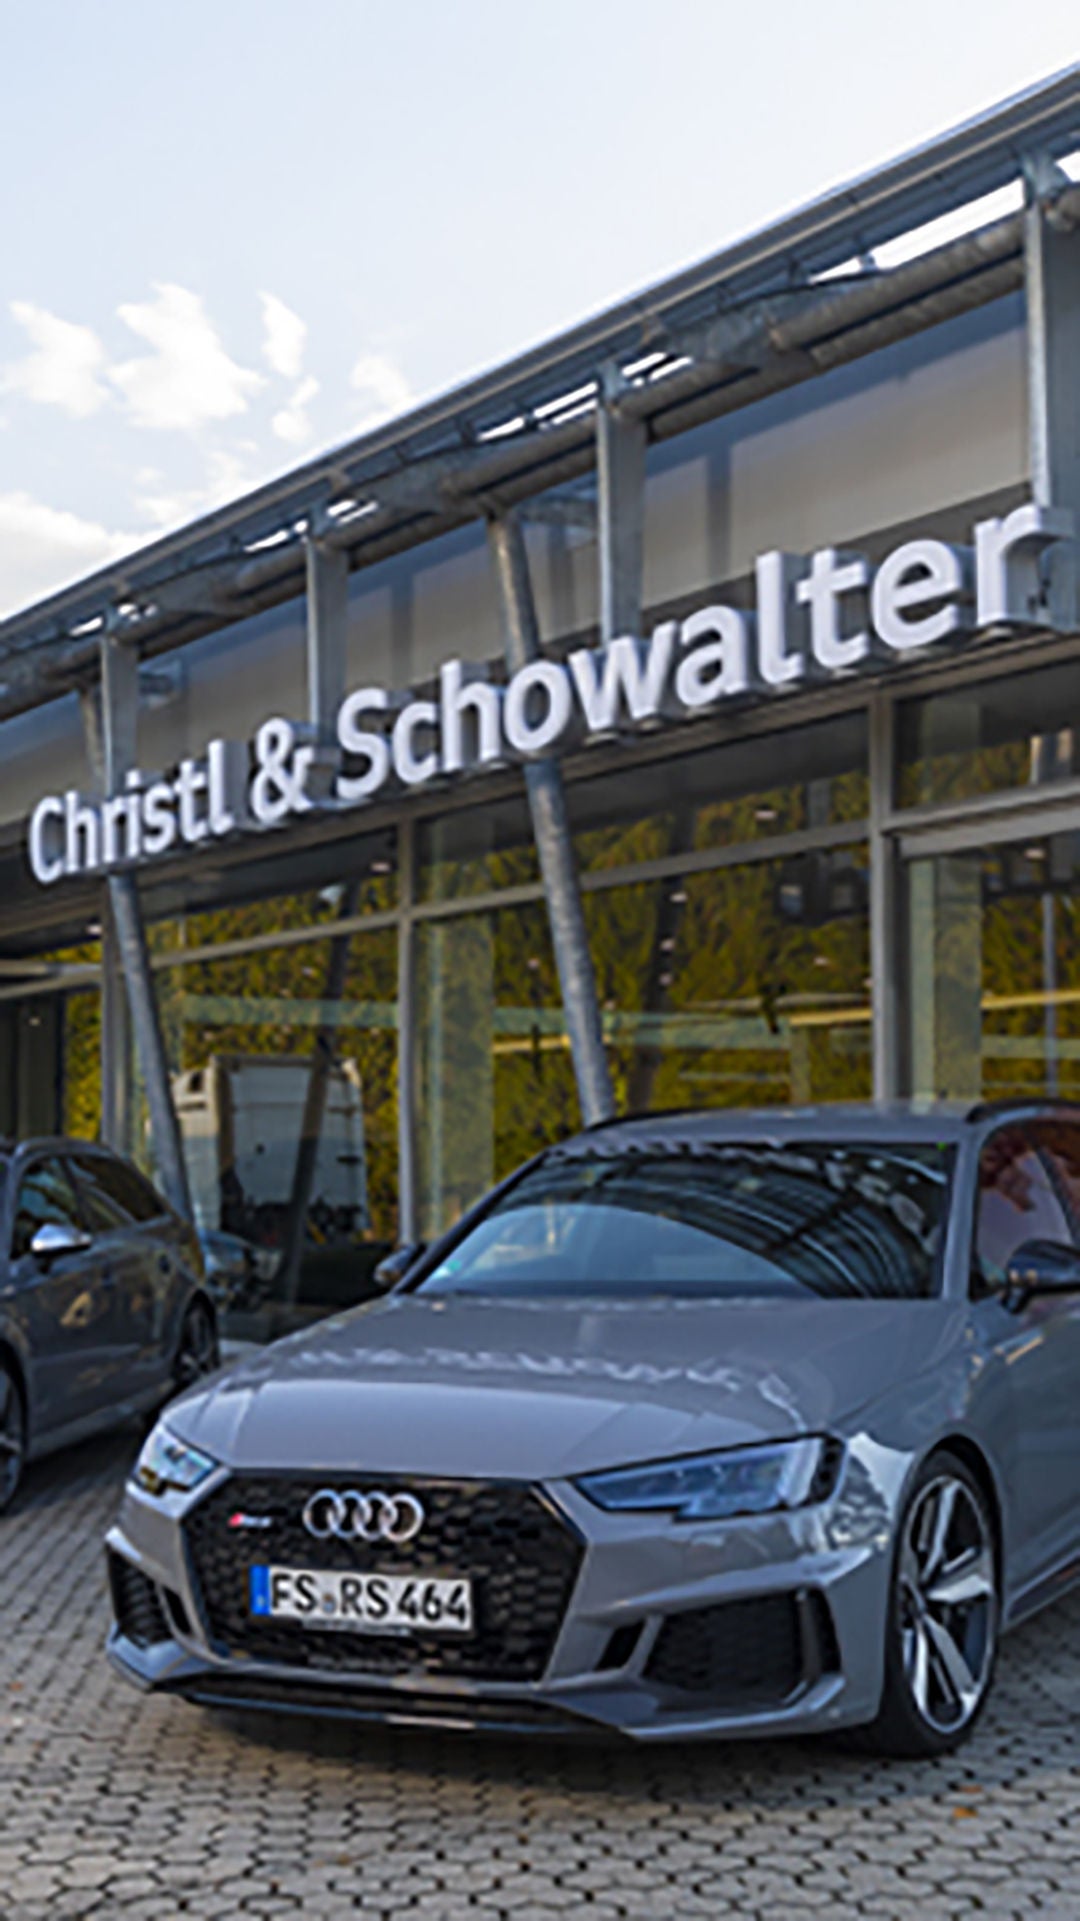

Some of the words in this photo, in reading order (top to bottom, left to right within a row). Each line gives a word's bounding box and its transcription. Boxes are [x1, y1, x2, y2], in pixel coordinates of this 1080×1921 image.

[29, 739, 234, 884] Christl
[251, 718, 313, 824] &
[336, 503, 1042, 799] Schowalter
[271, 1573, 317, 1613] FS
